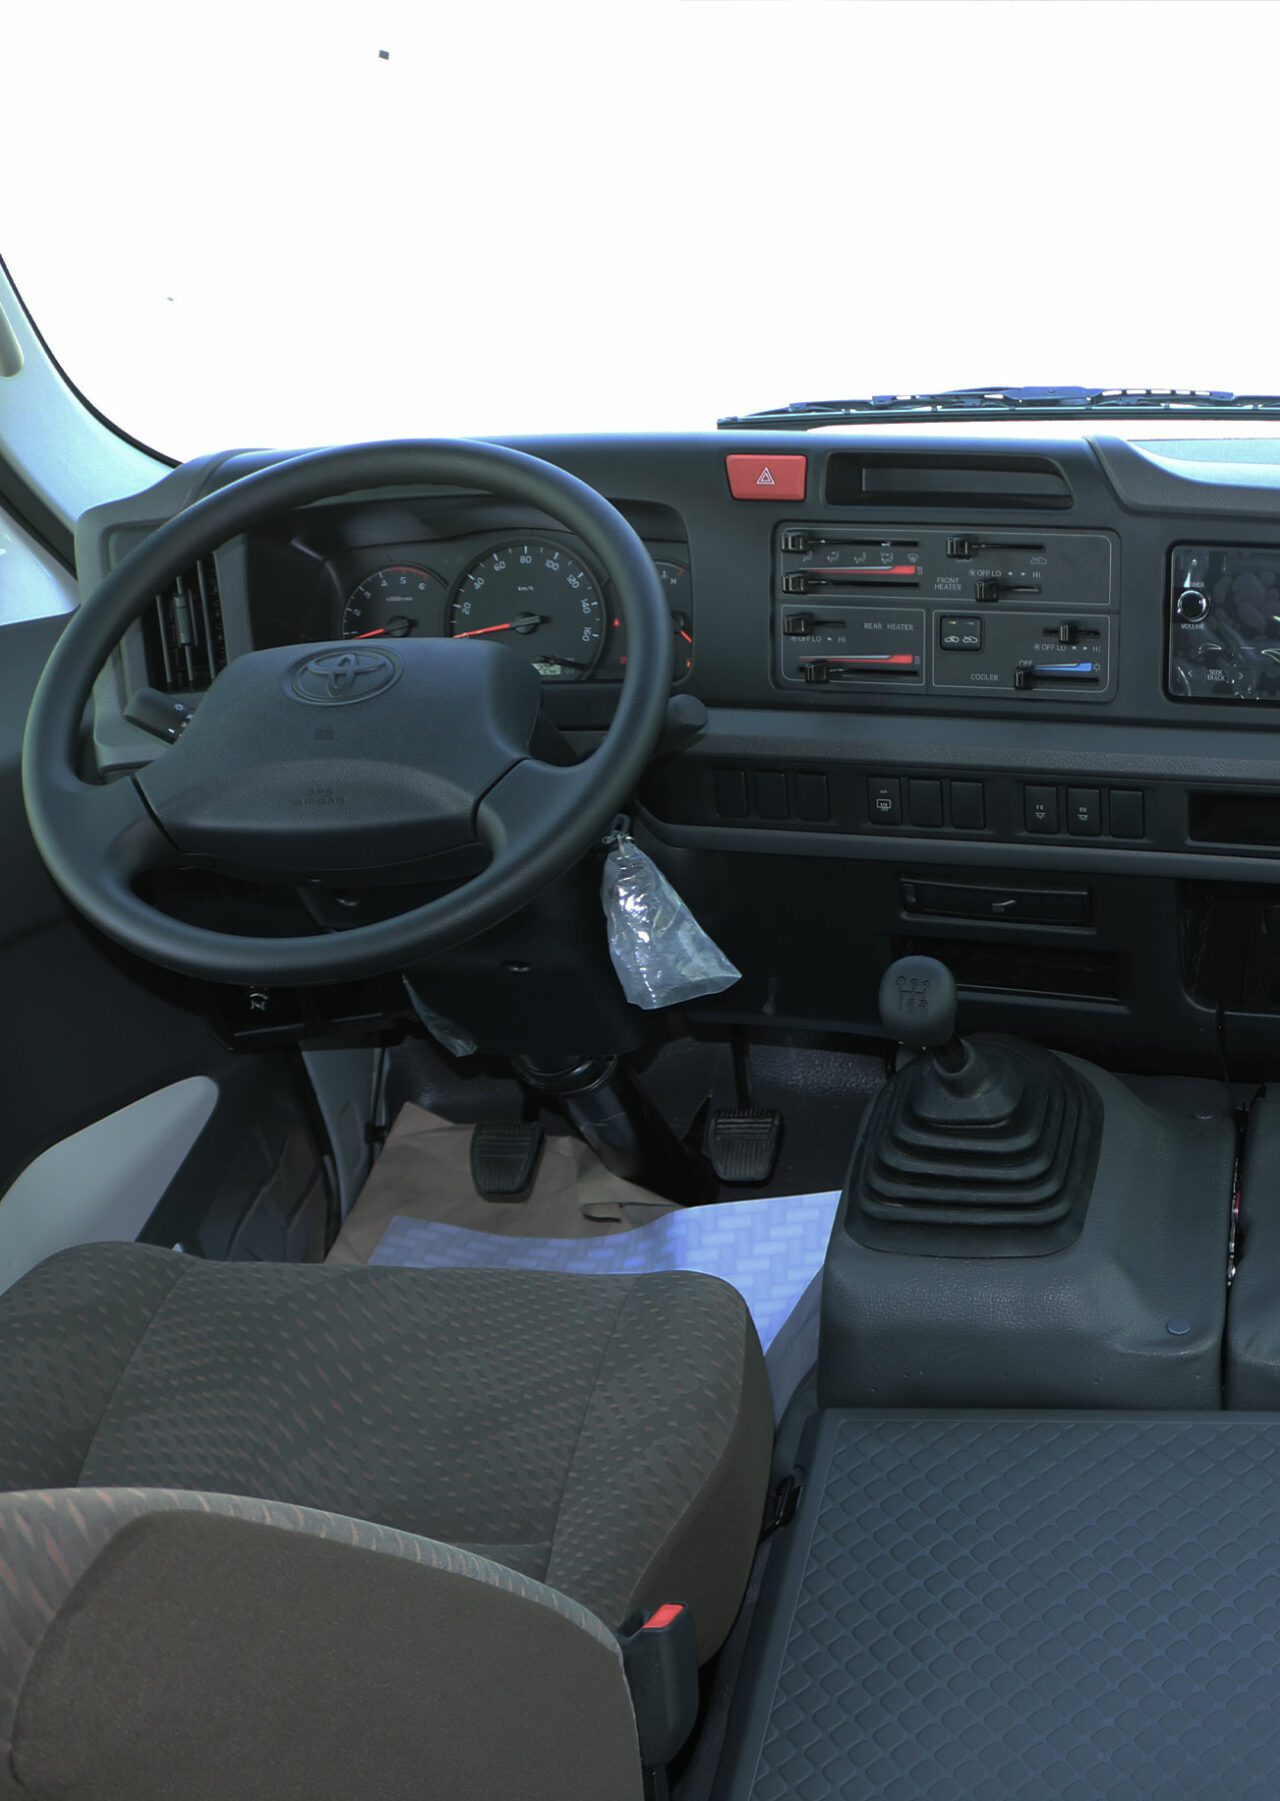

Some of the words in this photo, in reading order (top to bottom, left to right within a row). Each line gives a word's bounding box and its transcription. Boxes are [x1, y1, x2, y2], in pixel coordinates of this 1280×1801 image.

[519, 555, 533, 564] 80
[493, 560, 507, 572] 60
[544, 559, 560, 571] 100
[399, 576, 408, 584] 5
[473, 577, 485, 590] 40
[566, 574, 580, 589] 120
[670, 577, 677, 585] H
[417, 582, 427, 591] 6
[934, 583, 962, 591] HEATER
[461, 602, 472, 615] 20
[580, 598, 591, 614] 140
[863, 622, 882, 630] REAR
[887, 623, 914, 631] HEATER
[1181, 623, 1206, 631] VOLUME
[582, 627, 592, 642] 160
[970, 673, 999, 681] COOLER
